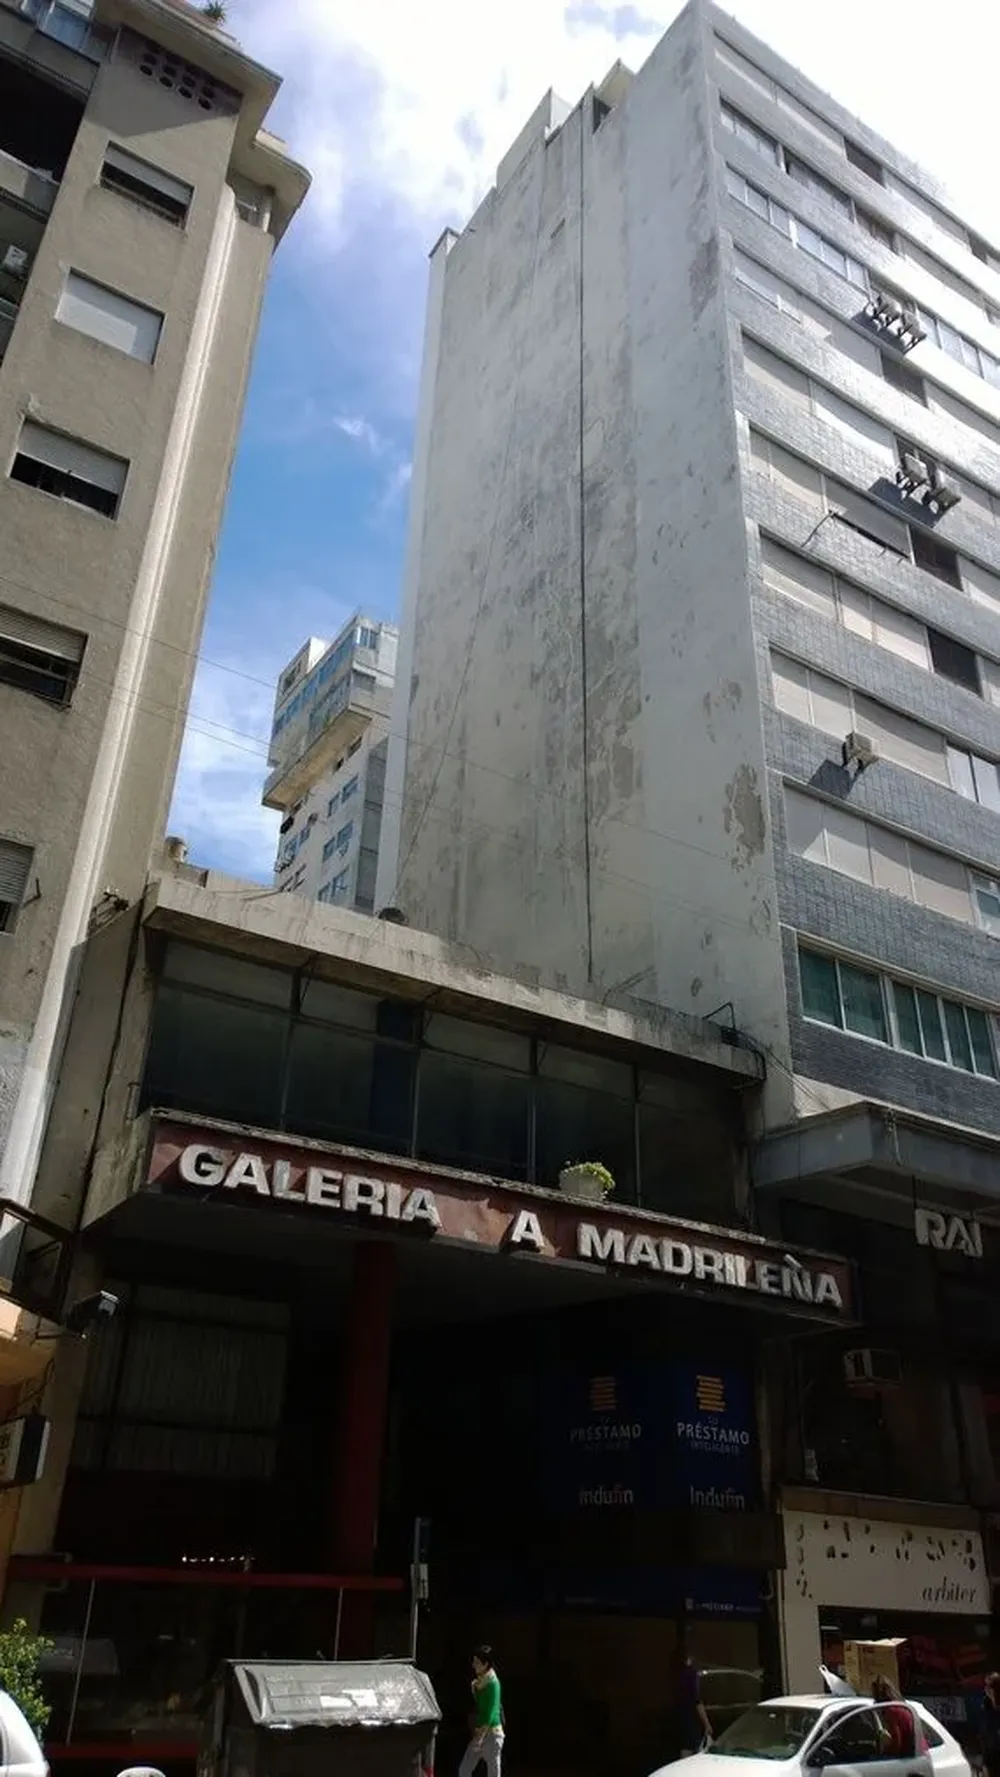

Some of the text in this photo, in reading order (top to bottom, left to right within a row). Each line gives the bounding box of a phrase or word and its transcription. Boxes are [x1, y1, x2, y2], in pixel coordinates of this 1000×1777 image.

[178, 1143, 441, 1228] GALERIA
[576, 1221, 843, 1309] MADRILEÑA
[675, 1420, 750, 1446] PRÉSTAMO
